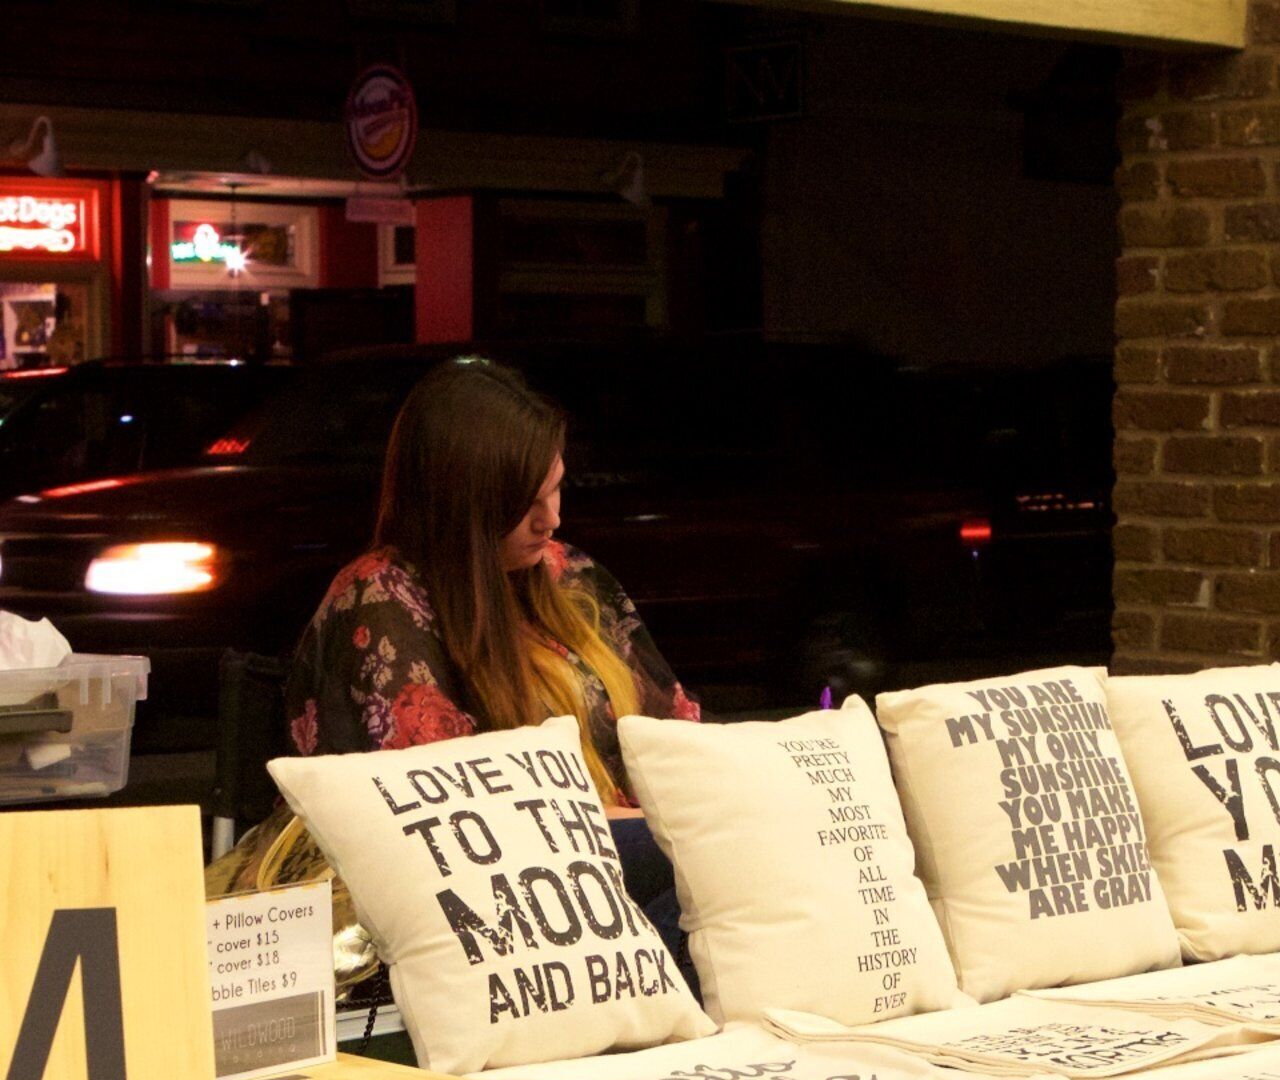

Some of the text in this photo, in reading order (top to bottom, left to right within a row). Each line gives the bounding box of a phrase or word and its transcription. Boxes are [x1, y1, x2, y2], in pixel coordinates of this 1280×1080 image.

[19, 196, 77, 231] Dogs
[965, 679, 1084, 713] YOU ARE
[945, 701, 1113, 748] MY SUNSHINE
[777, 738, 840, 753] YOU'RE
[995, 730, 1104, 768] MY ONLY
[790, 751, 851, 768] PRETTY
[371, 749, 590, 816] LOVE YOU
[805, 767, 857, 786] MUCH
[999, 757, 1127, 799] SUNSHINE
[827, 786, 853, 803] MY
[998, 784, 1137, 829] YOU MAKE
[827, 804, 872, 824] MOST
[402, 798, 618, 878] TO THE
[816, 823, 889, 847] FAVORITE
[1011, 812, 1145, 861] ME HAPPY
[853, 845, 874, 863] OF
[858, 865, 888, 884] ALL
[994, 850, 1093, 893] WHEN
[858, 885, 896, 905] TIME
[1028, 871, 1153, 920] ARE GRAY
[225, 912, 264, 931] Pillow
[267, 904, 315, 924] Covers
[872, 907, 891, 926] IN
[216, 930, 280, 954] cover $15
[870, 928, 901, 948] THE
[216, 950, 281, 975] cover $18
[857, 947, 918, 973] HISTORY
[248, 977, 277, 997] Tiles
[281, 971, 298, 988] $9
[487, 948, 680, 1025] AND BACK
[882, 972, 902, 991] OF
[872, 991, 908, 1014] EVER
[220, 1016, 297, 1052] WILDWOOD
